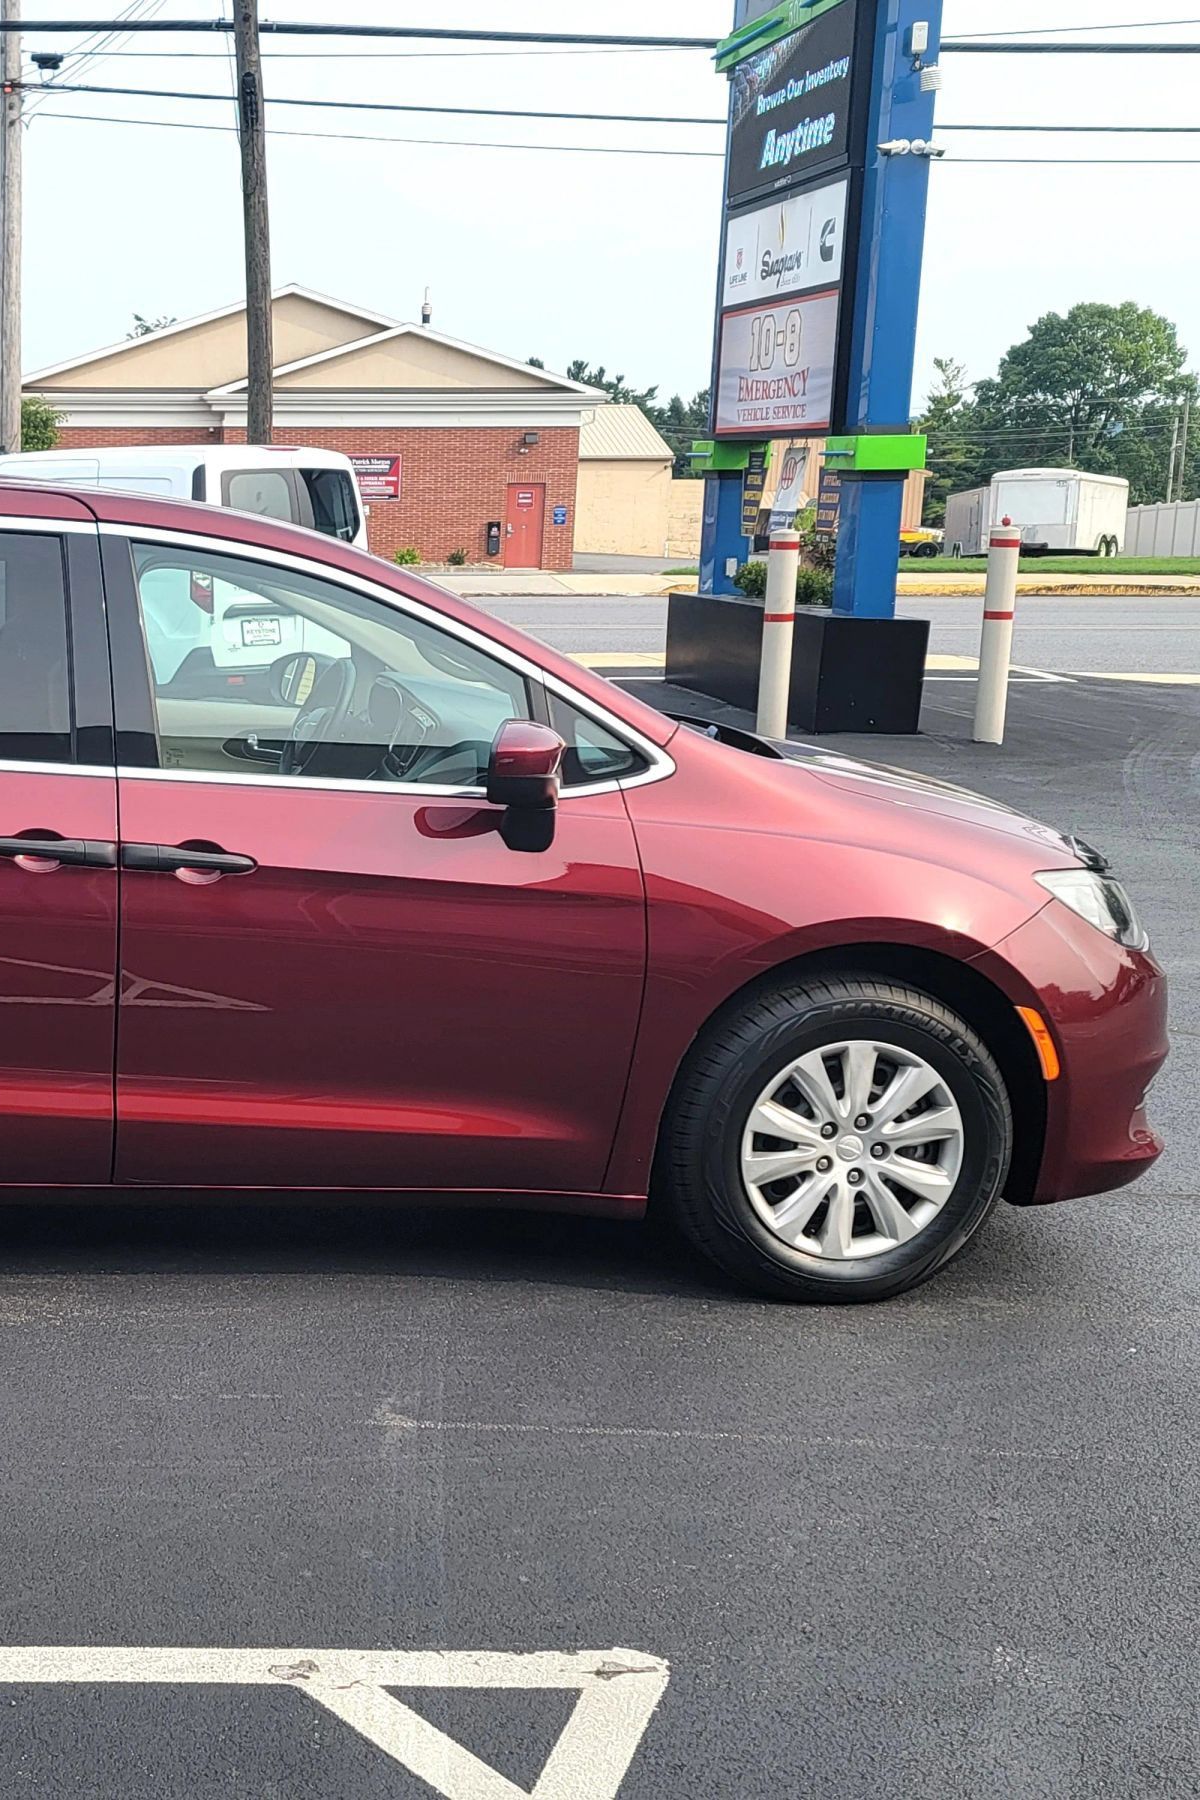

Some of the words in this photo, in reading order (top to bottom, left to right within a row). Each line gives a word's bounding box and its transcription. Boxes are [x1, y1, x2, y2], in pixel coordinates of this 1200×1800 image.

[757, 88, 786, 115] Browse
[787, 79, 805, 100] Our
[805, 56, 850, 92] Inventory
[760, 112, 835, 169] Anytime
[760, 249, 802, 289] Seagrave
[749, 309, 802, 372] 10-8
[737, 366, 810, 403] EMERGENCY
[737, 406, 770, 422] VEHICLE
[772, 404, 807, 420] SERVICE
[831, 1001, 952, 1041] MAXTOUR
[948, 1038, 980, 1067] LX
